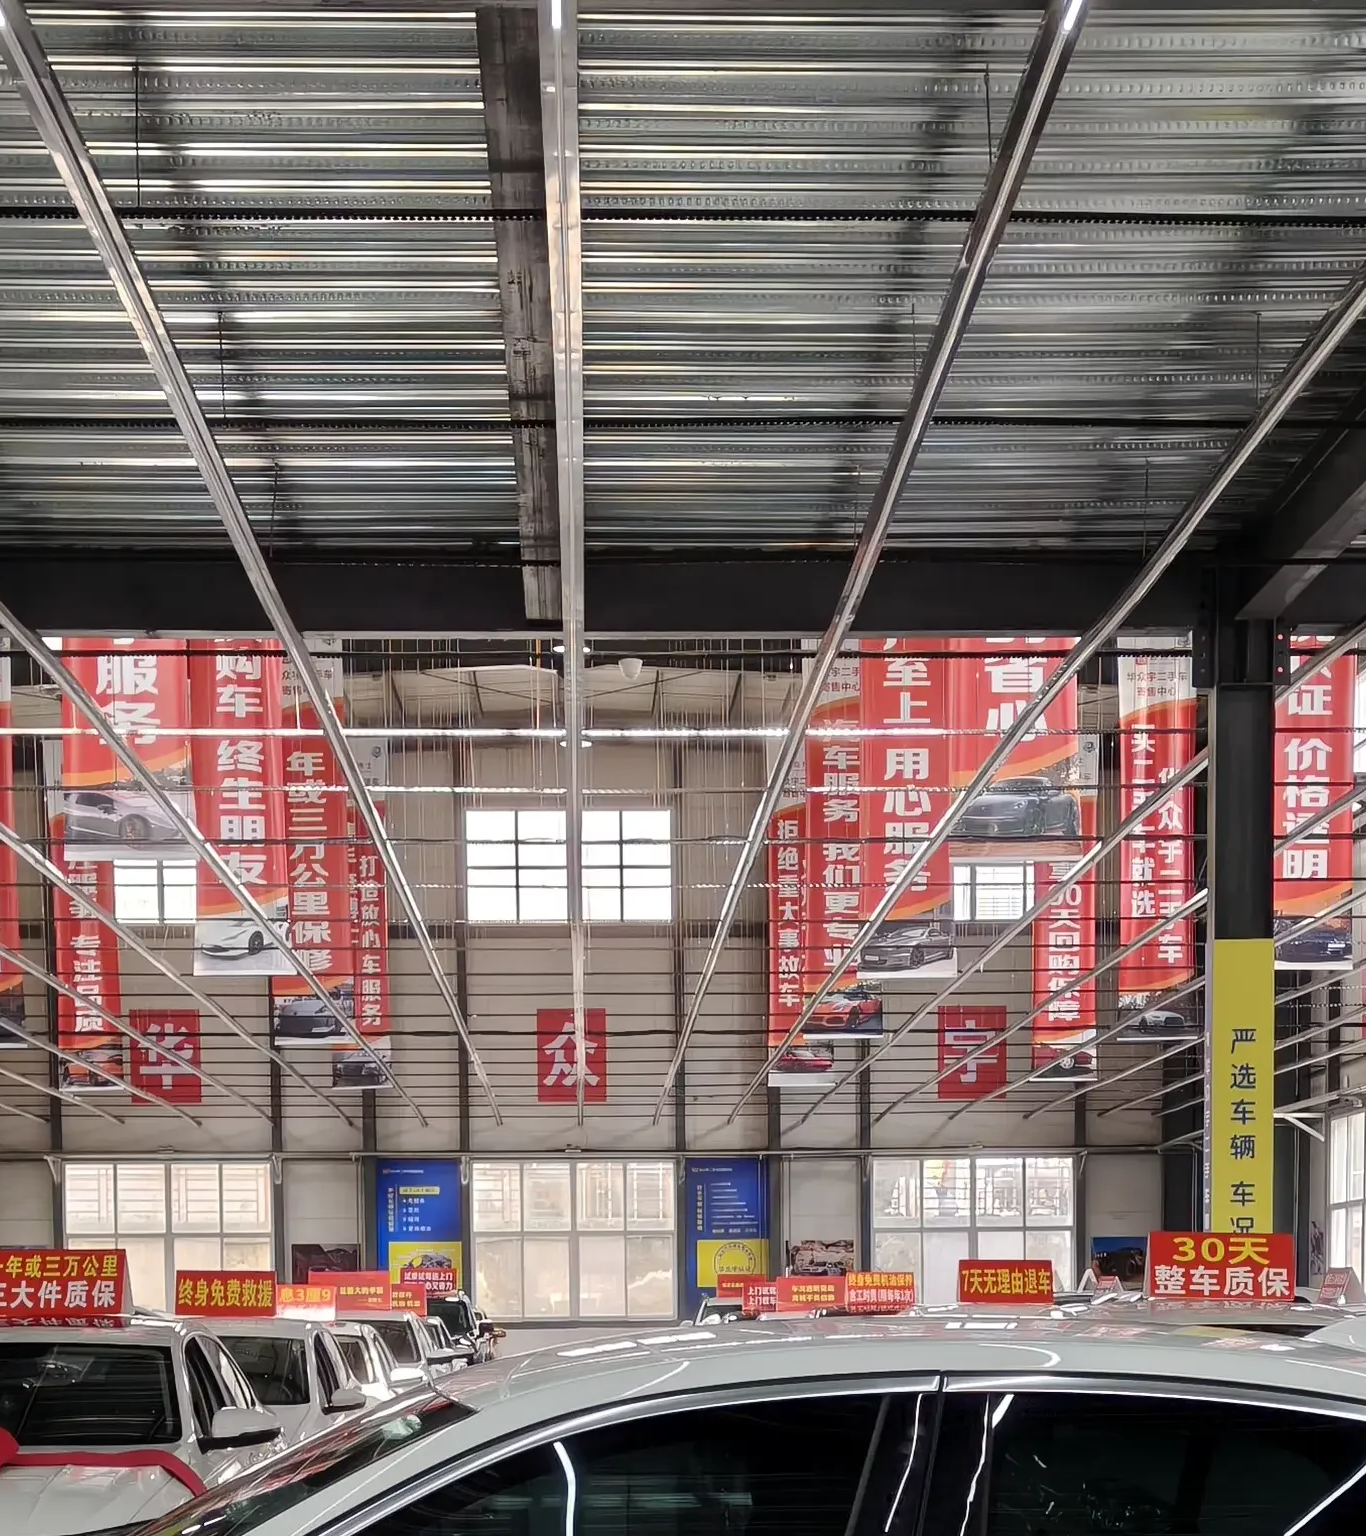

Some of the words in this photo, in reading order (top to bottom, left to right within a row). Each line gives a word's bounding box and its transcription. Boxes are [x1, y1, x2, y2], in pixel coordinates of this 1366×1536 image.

[96, 638, 161, 745] 服务
[216, 637, 263, 718] 购车
[883, 638, 931, 724] 至上
[984, 637, 1048, 742] 省心
[542, 1021, 601, 1087] 众
[1230, 1028, 1257, 1161] 严选车辆
[961, 1268, 1051, 1296] 7天无理由退车
[1153, 1264, 1291, 1298] 整车质保
[1173, 1237, 1271, 1265] 30天
[178, 1277, 273, 1308] 终身免费救援
